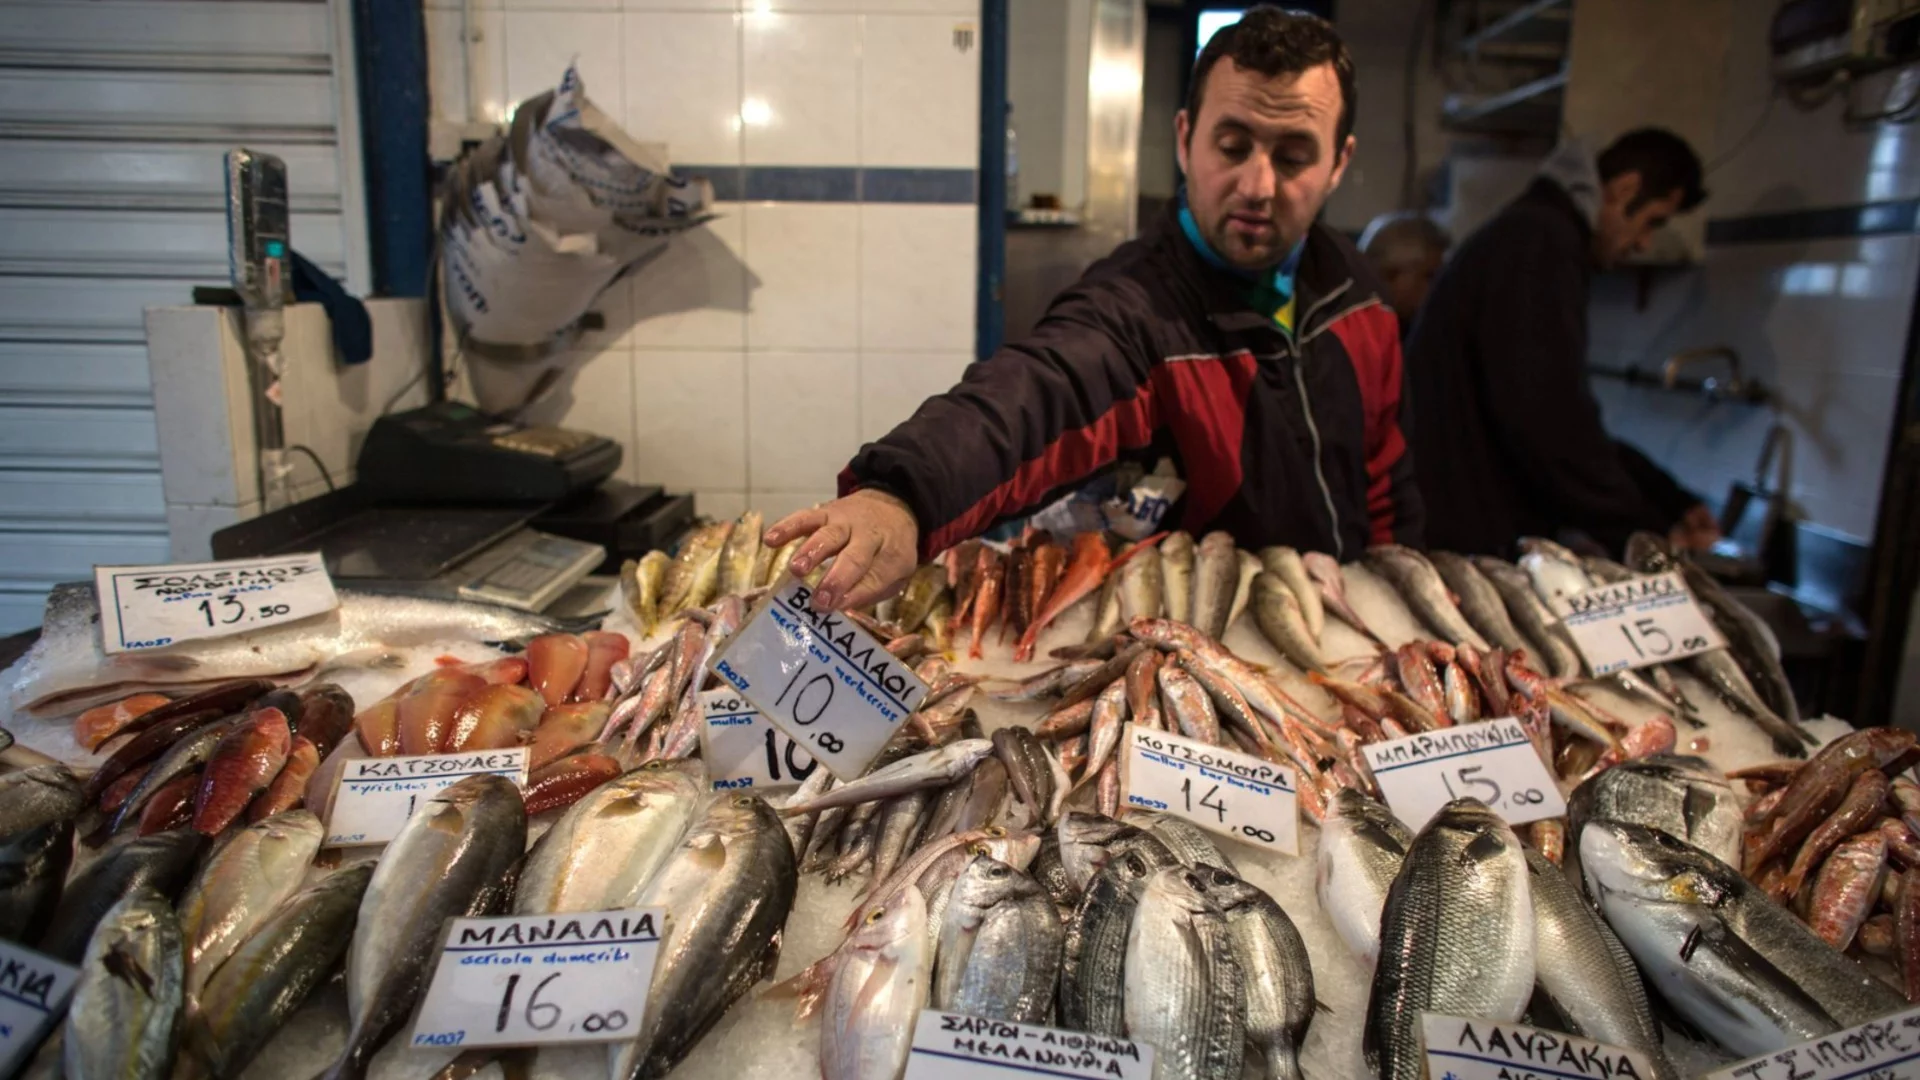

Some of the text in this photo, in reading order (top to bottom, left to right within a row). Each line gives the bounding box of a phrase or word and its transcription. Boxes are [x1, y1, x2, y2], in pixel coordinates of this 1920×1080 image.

[788, 587, 916, 701] ΒΑΚΑΛΑΟΙ
[711, 699, 750, 711] ΚΟ
[407, 793, 417, 820] 1
[460, 913, 657, 945] ΜΑΝΑΛΙΑ
[0, 957, 56, 1008] ΚΙΑ
[1459, 1022, 1642, 1080] ΛΑΥΡΑΚΙΑ
